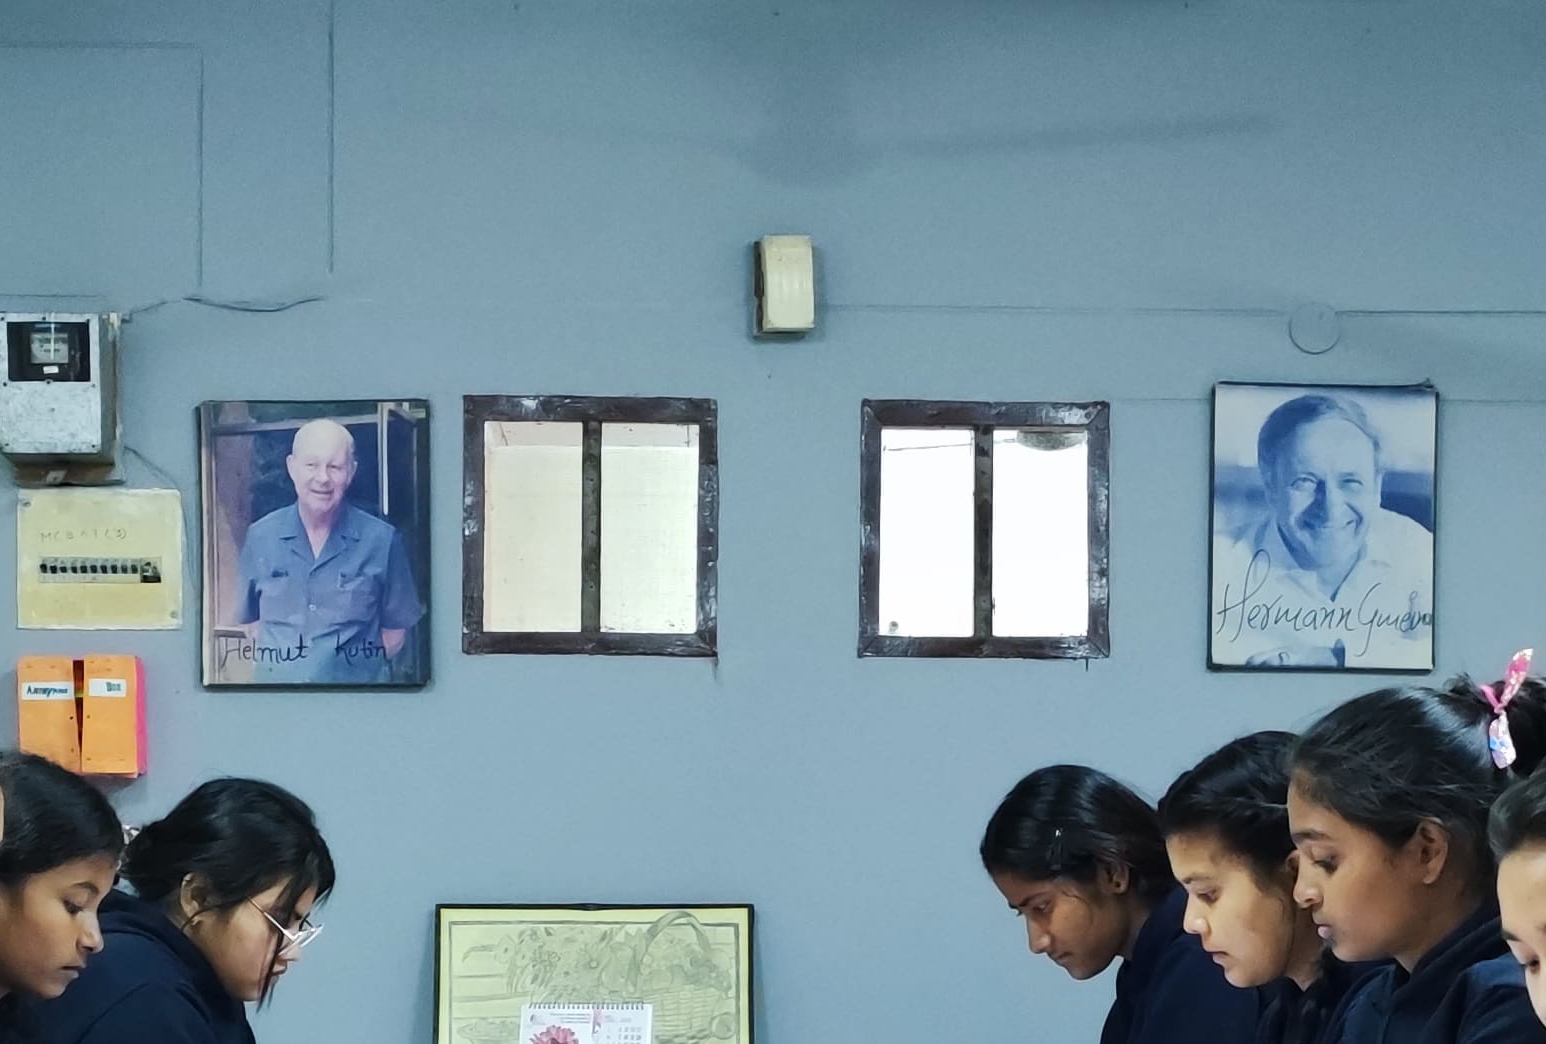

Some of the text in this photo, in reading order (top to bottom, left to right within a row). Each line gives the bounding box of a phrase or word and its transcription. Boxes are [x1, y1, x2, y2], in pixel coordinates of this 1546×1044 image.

[1217, 548, 1355, 643] Hermann
[220, 632, 393, 669] Helmut Kutin
